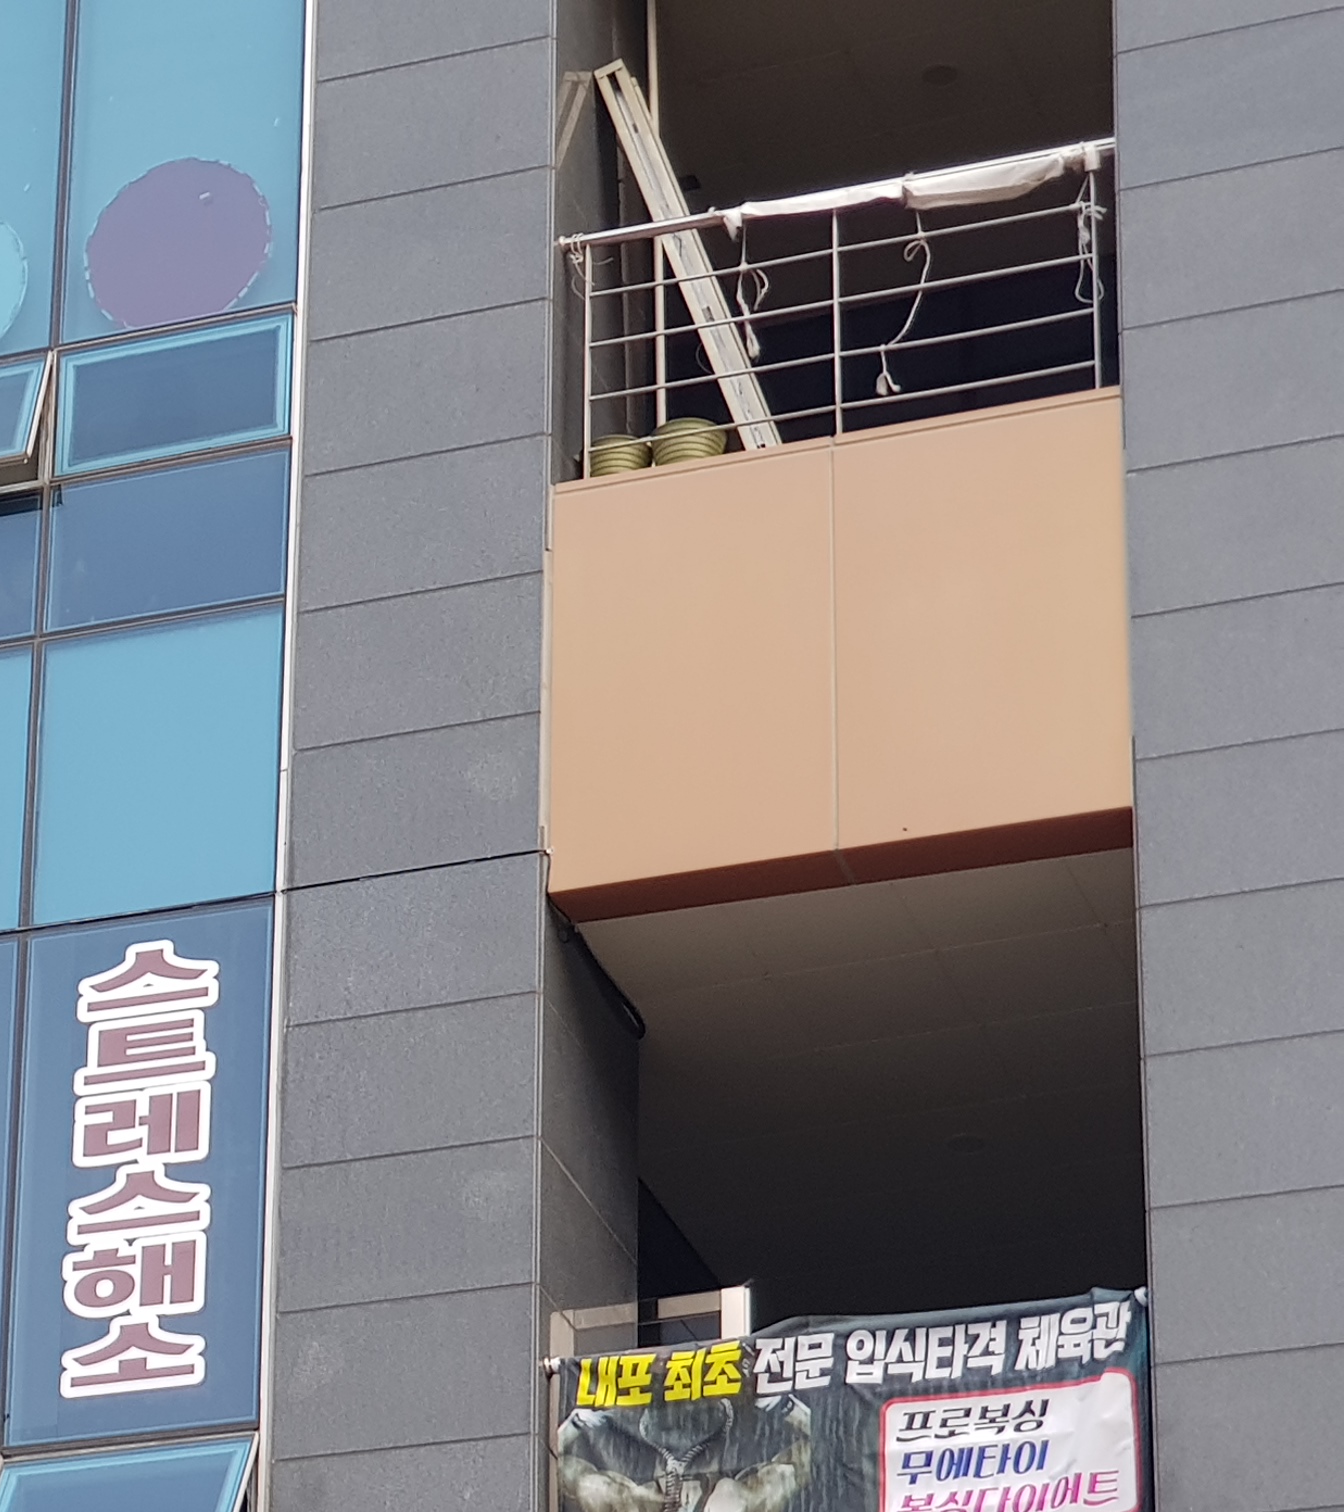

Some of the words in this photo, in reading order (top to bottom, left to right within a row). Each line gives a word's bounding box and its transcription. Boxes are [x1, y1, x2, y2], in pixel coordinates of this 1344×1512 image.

[60, 940, 219, 1398] 스트레스해소
[576, 1353, 655, 1407] 내포
[663, 1340, 743, 1402] 최초
[753, 1333, 835, 1396] 전문
[844, 1320, 1008, 1384] 입식타격
[1014, 1300, 1133, 1372] 체육관
[896, 1398, 1050, 1442] 프로복싱
[897, 1439, 1050, 1485] 무에타이
